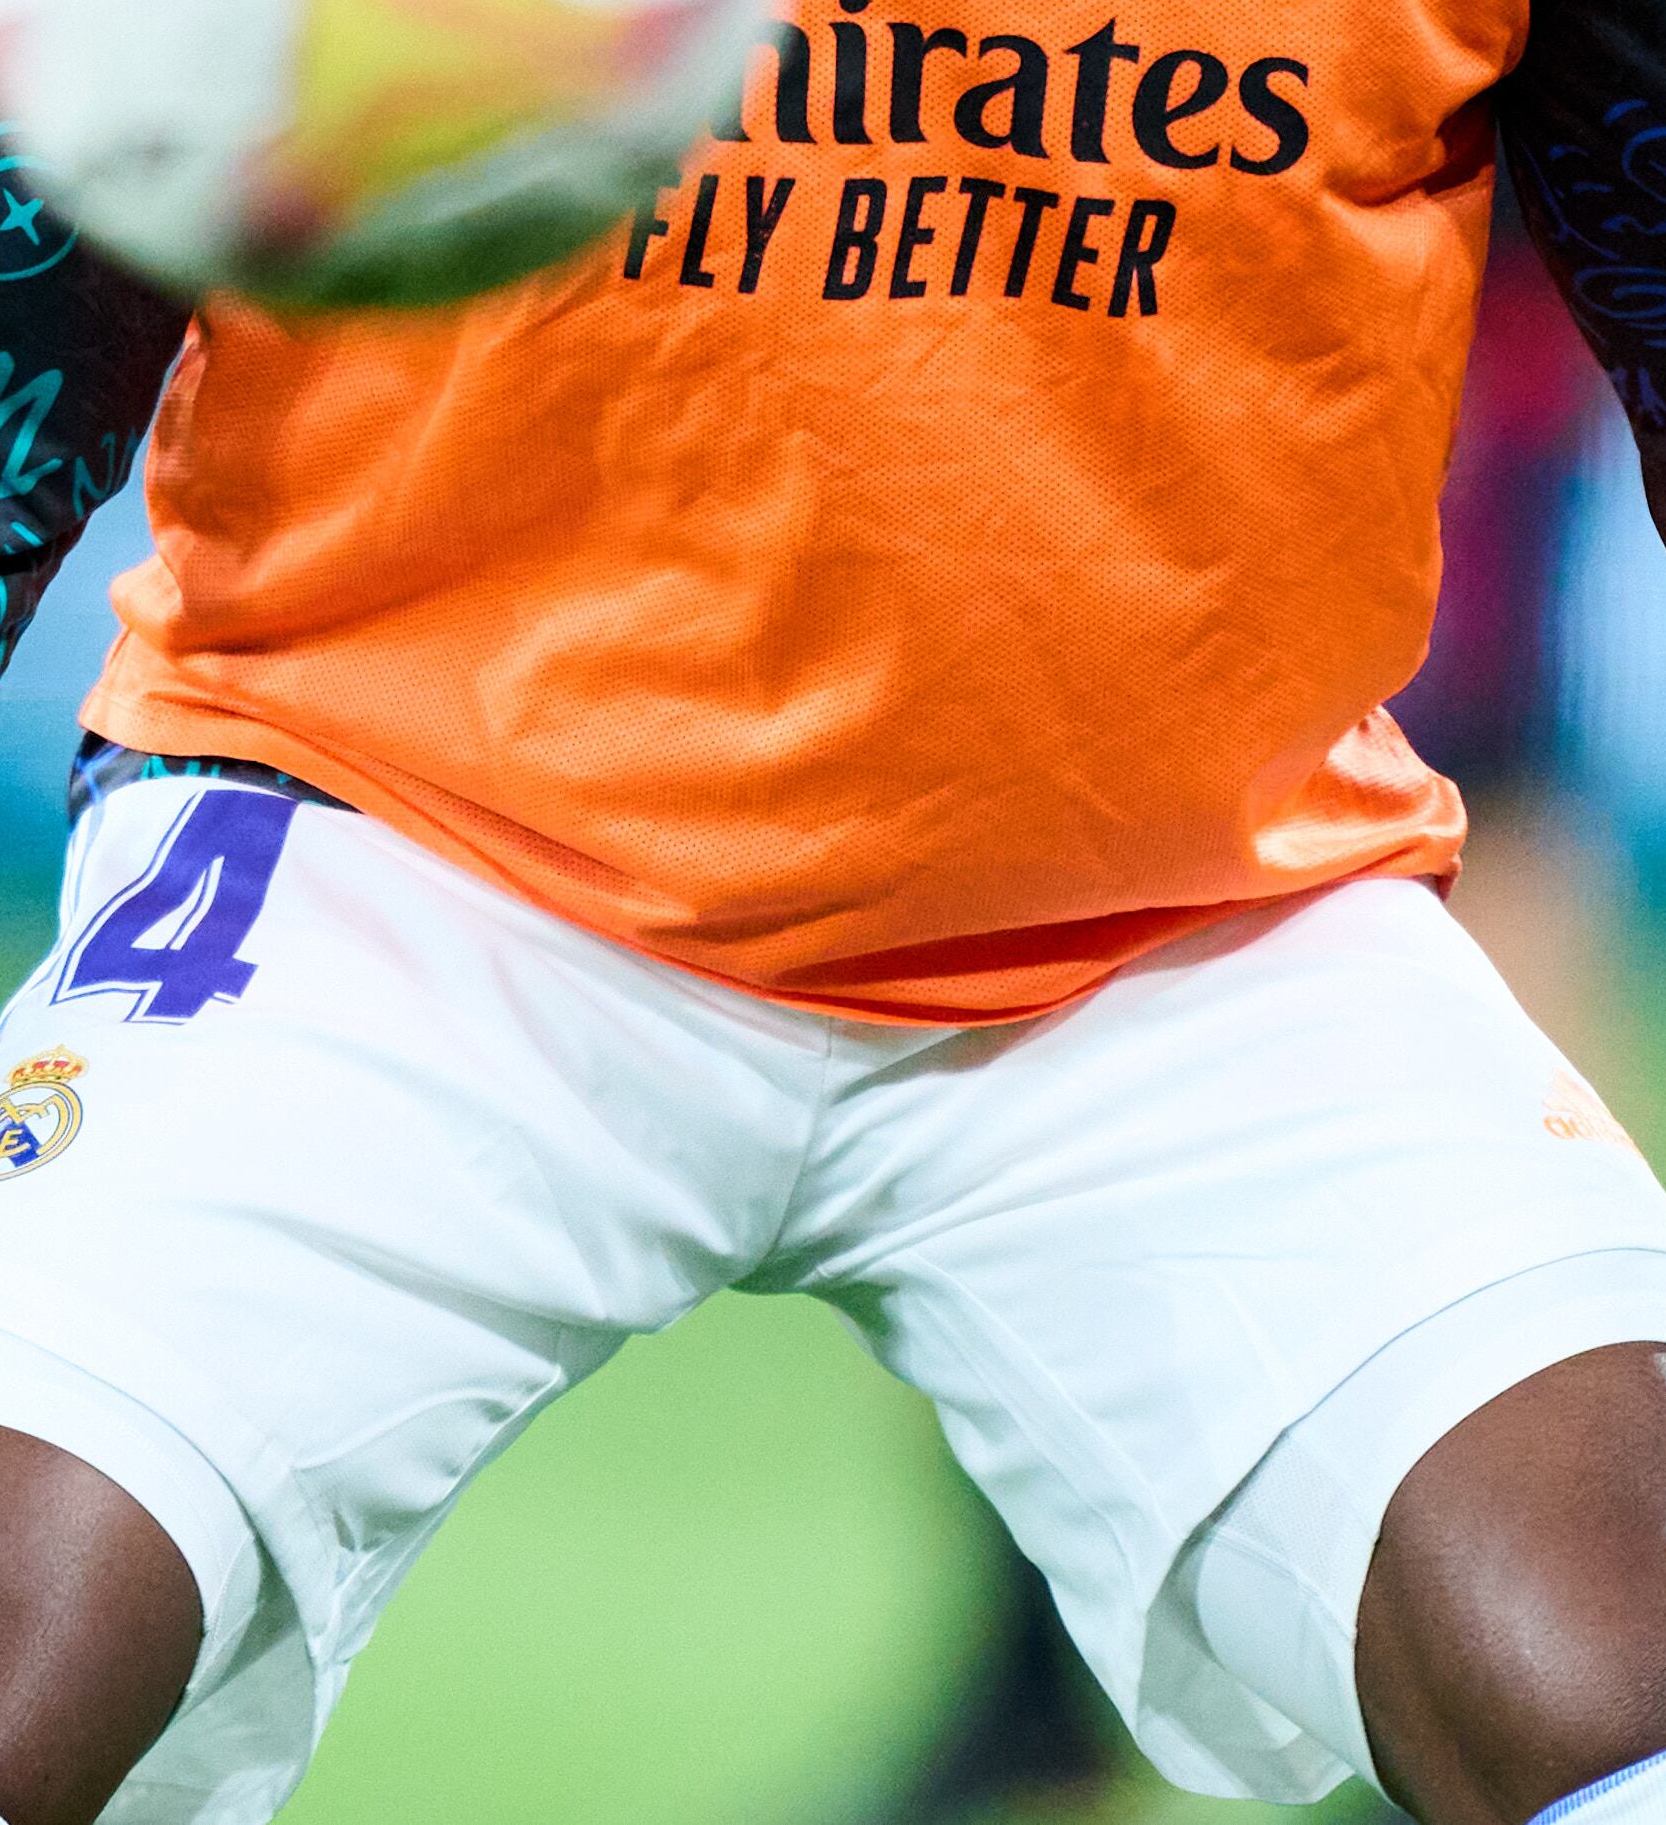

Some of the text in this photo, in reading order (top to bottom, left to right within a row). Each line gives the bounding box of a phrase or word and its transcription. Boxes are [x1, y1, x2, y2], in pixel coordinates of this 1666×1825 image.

[623, 173, 1177, 318] FLY BETTER
[48, 787, 300, 1025] 4
